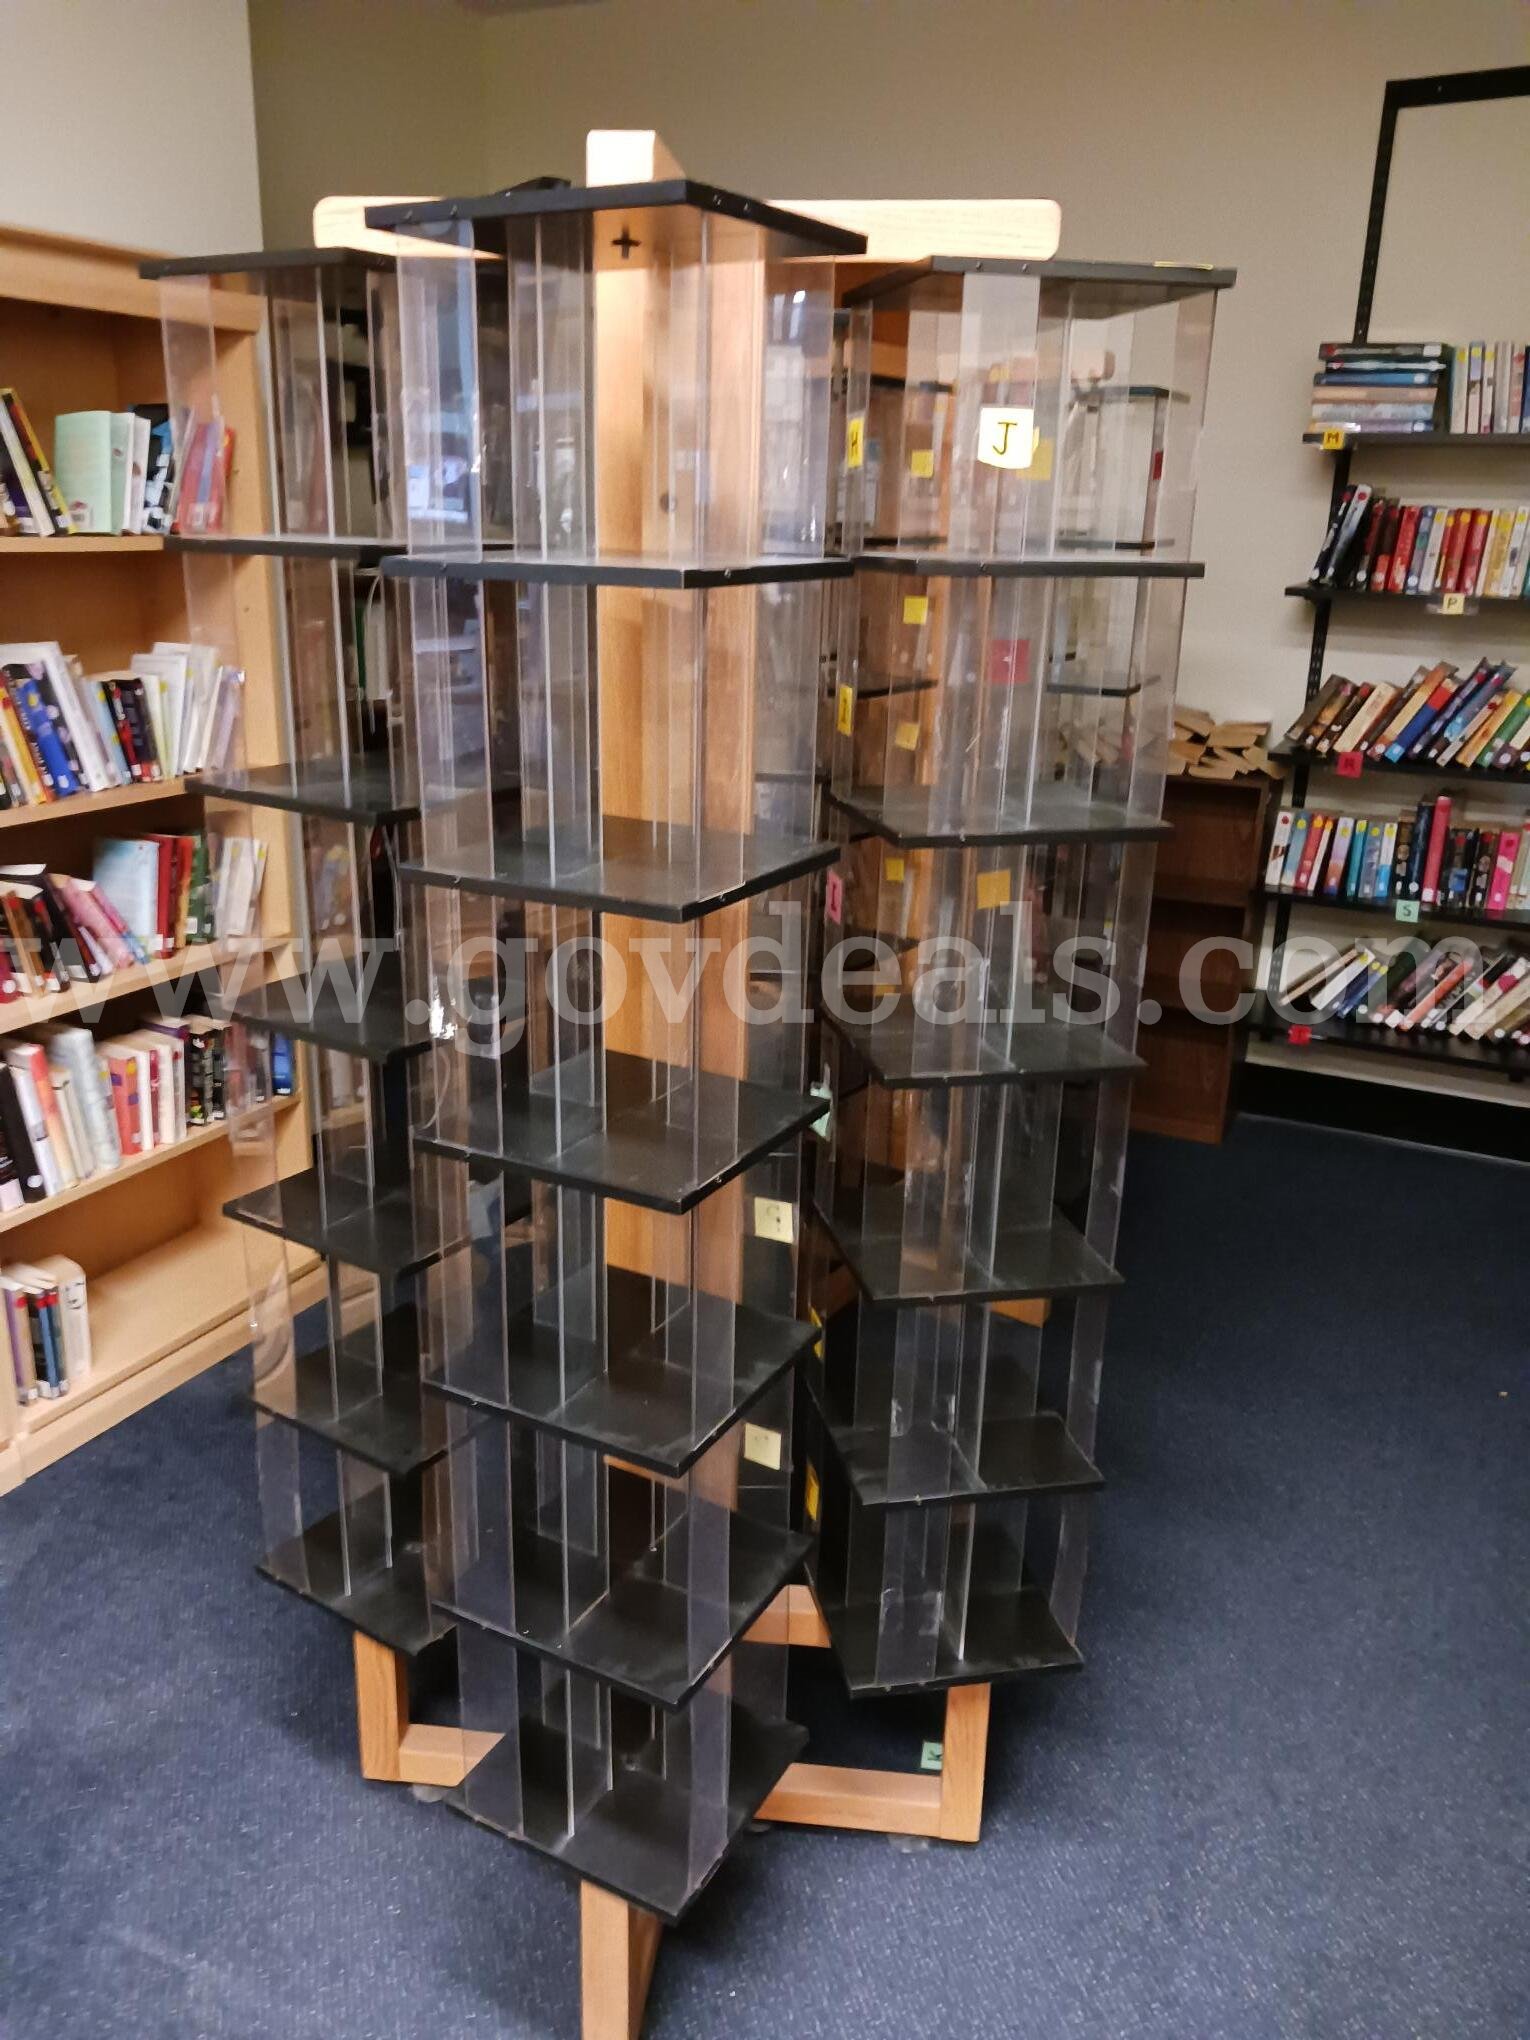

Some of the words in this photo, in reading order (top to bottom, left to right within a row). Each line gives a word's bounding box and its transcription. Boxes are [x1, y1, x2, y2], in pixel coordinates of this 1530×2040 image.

[992, 421, 1018, 456] J
[1326, 431, 1340, 444] M
[1446, 597, 1459, 609] P
[1403, 904, 1412, 917] S
